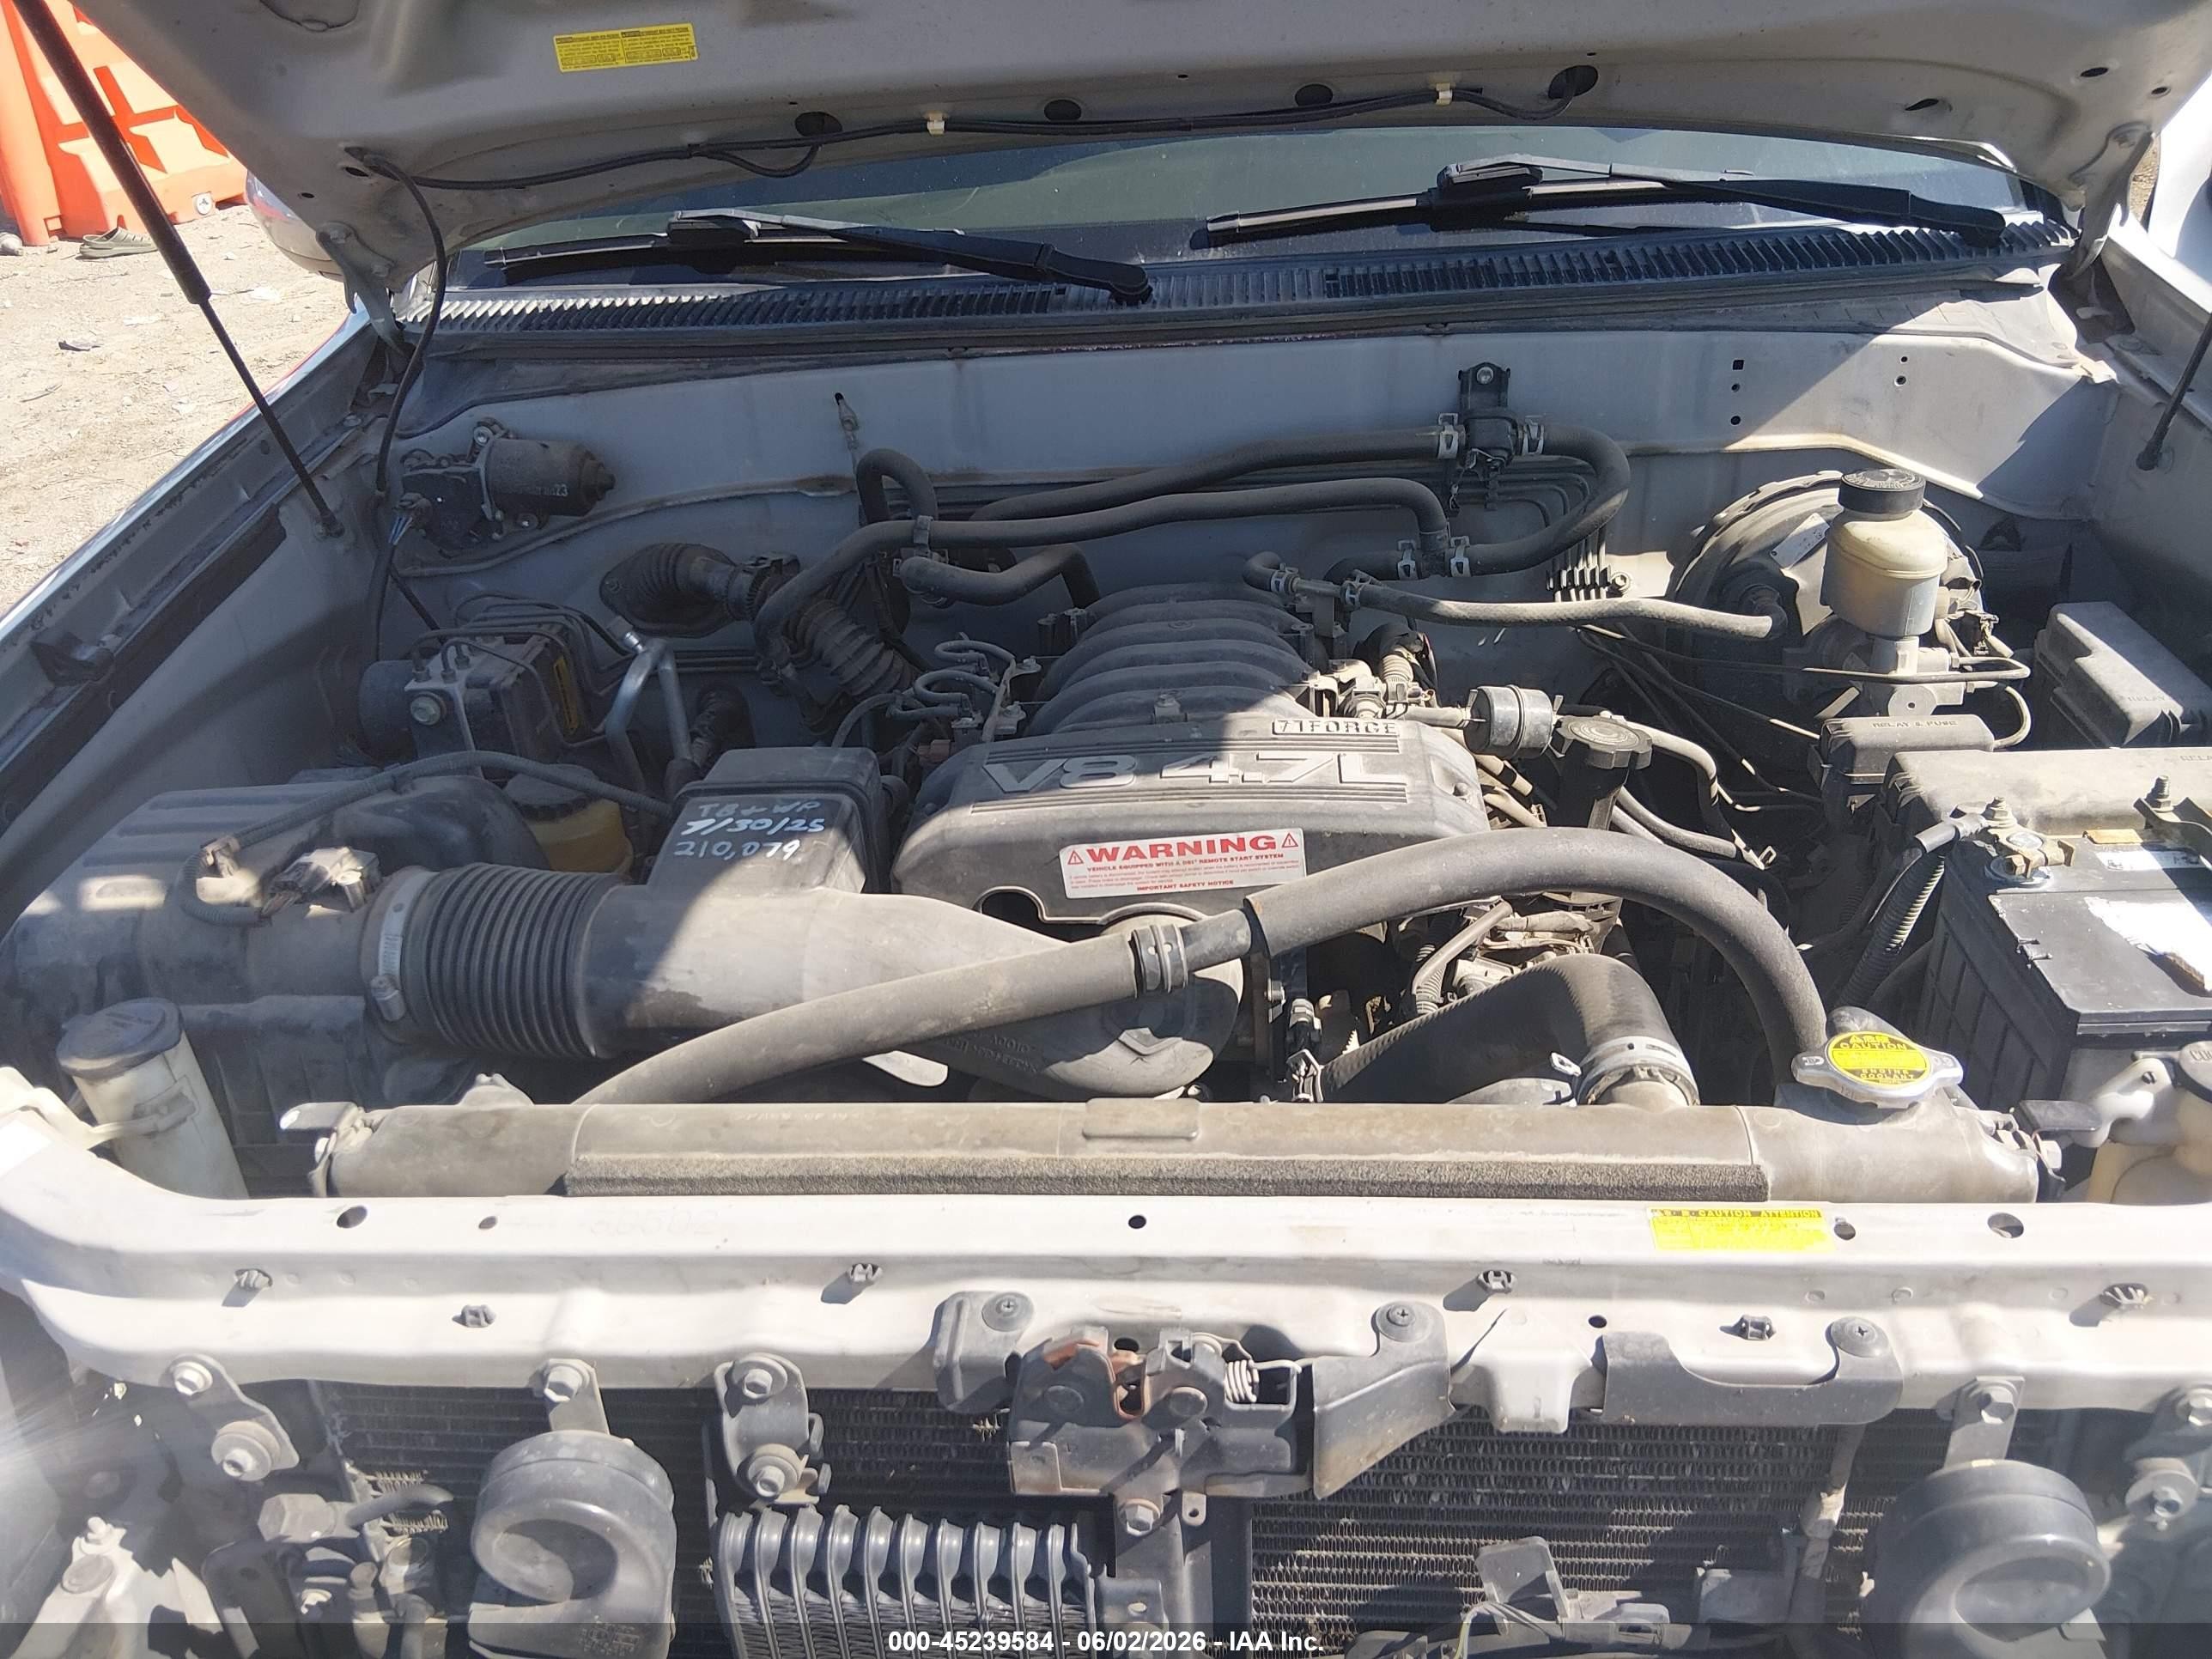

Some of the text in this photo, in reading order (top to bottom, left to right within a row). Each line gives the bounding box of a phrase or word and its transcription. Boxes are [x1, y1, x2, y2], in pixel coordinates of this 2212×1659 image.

[982, 751, 1407, 793] V8 4.7L
[681, 817, 825, 836] 7/30/25
[673, 838, 800, 861] 210,079
[1086, 836, 1276, 863] WARNING
[1698, 1209, 1752, 1218] CAUTION
[1760, 1209, 1819, 1218] ATTENTION
